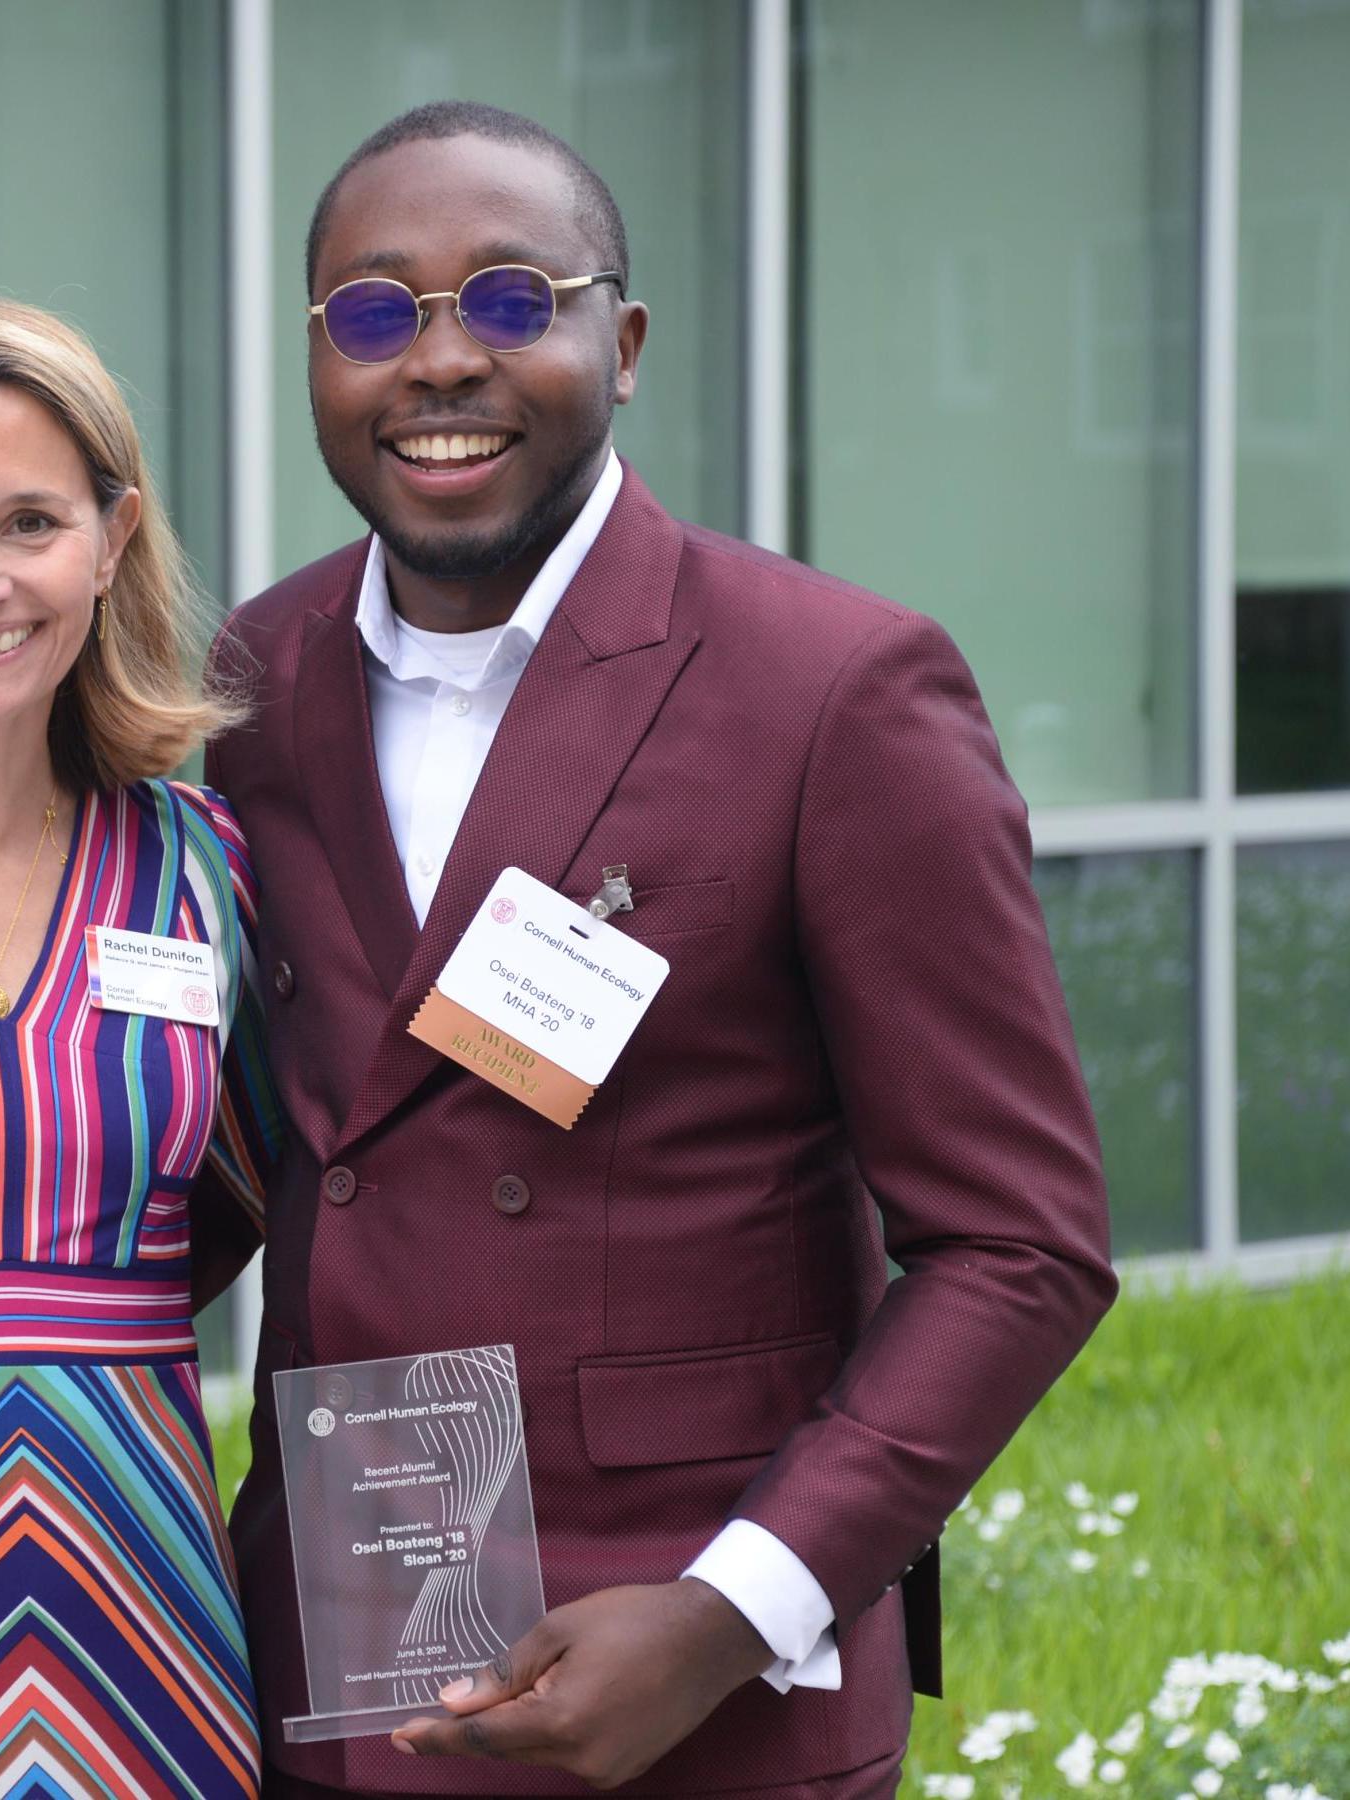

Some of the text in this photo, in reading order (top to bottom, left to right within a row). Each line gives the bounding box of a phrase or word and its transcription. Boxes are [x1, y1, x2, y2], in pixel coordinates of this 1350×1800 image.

[104, 938, 148, 955] Rachel
[152, 947, 203, 964] Dunifon
[524, 921, 646, 1002] Cornell Human Ecology
[106, 984, 135, 995] Cornell
[107, 993, 135, 1002] Human
[489, 959, 596, 1031] Osei Boateng '18
[502, 991, 560, 1032] MHA '20
[479, 1027, 536, 1068] AWARD
[451, 1034, 540, 1096] RECIPIENT
[344, 1409, 387, 1424] Cornell
[388, 1406, 429, 1420] Human
[430, 1401, 478, 1414] Ecology
[364, 1460, 436, 1478] Recent Alumni
[352, 1472, 451, 1492] Achievement Award
[380, 1521, 434, 1534] Presented to:
[352, 1531, 465, 1555] Osei Boateng '18
[403, 1549, 467, 1567] Sloan '20
[396, 1649, 416, 1659] June
[426, 1645, 447, 1656] 2024
[345, 1672, 372, 1683] Cornell
[373, 1668, 401, 1680] Human
[401, 1666, 433, 1677] Ecology
[433, 1663, 459, 1673] Alumni
